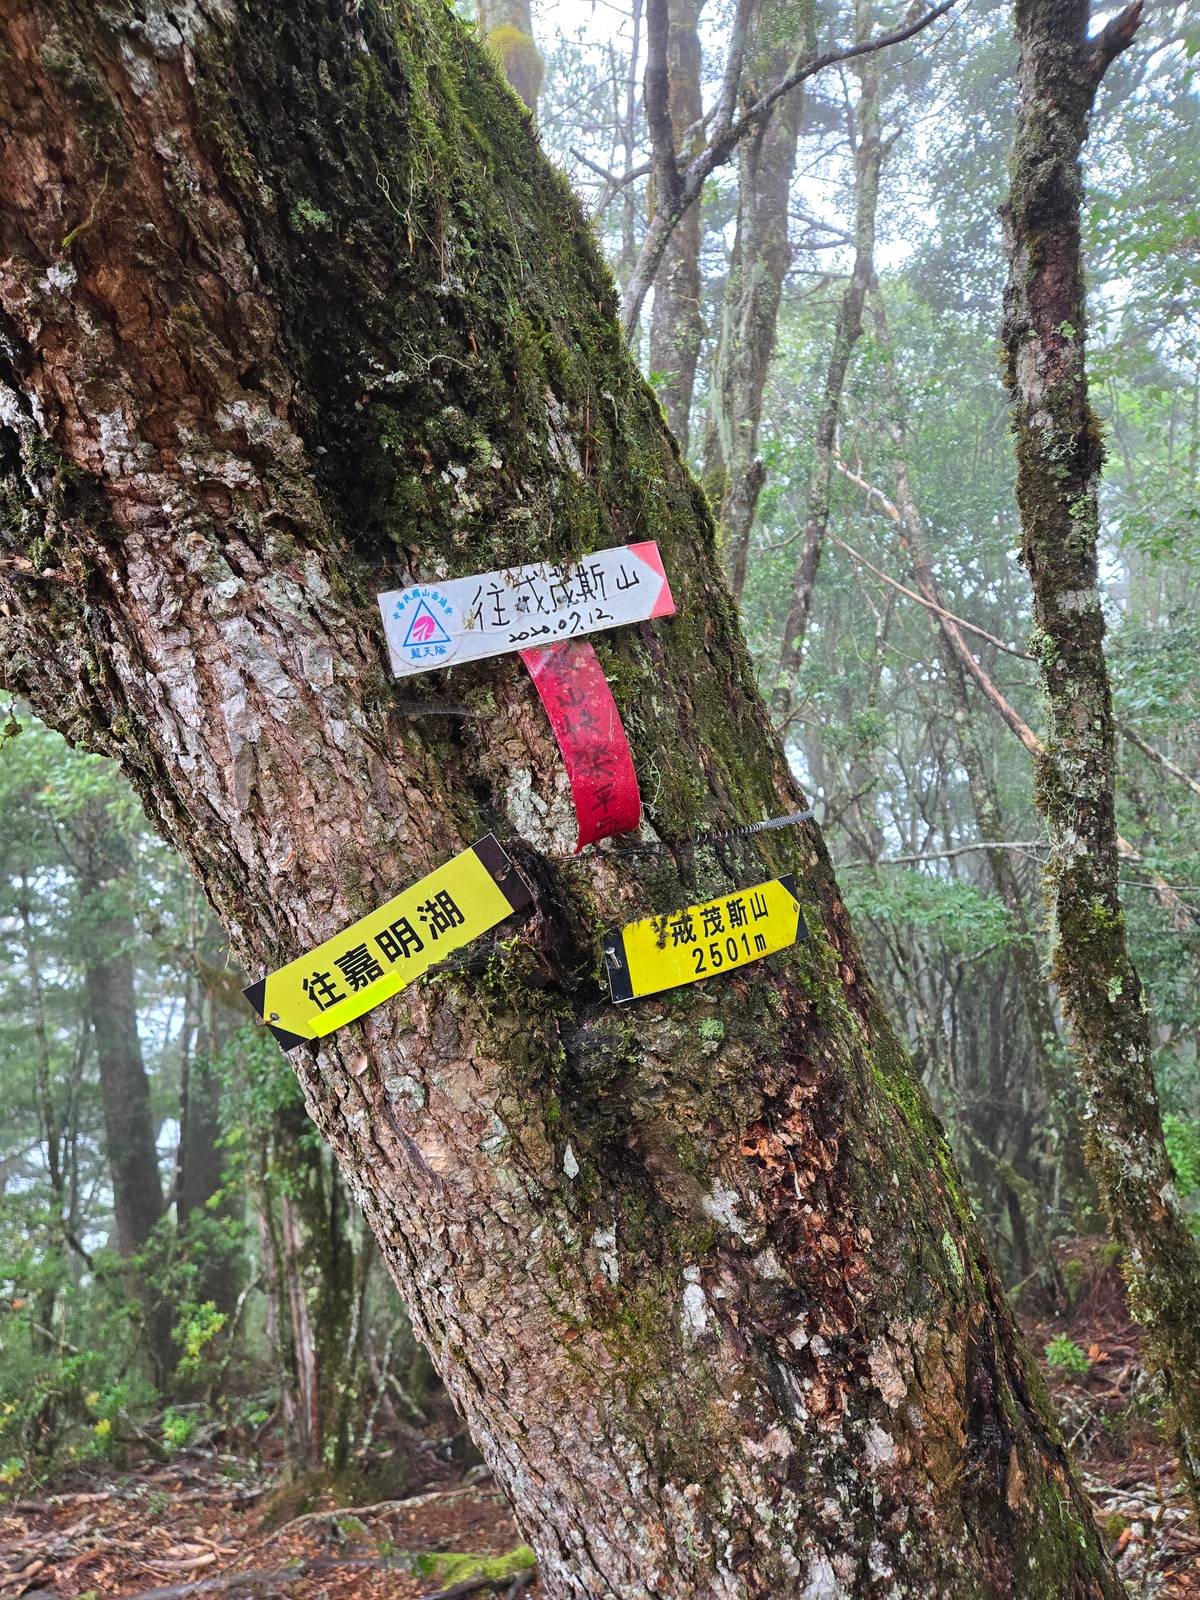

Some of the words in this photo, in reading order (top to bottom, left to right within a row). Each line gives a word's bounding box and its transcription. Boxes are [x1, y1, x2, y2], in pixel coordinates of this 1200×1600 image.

[410, 645, 447, 660] 藍天隊
[301, 889, 466, 1012] 往嘉明湖
[691, 932, 768, 975] 2501m
